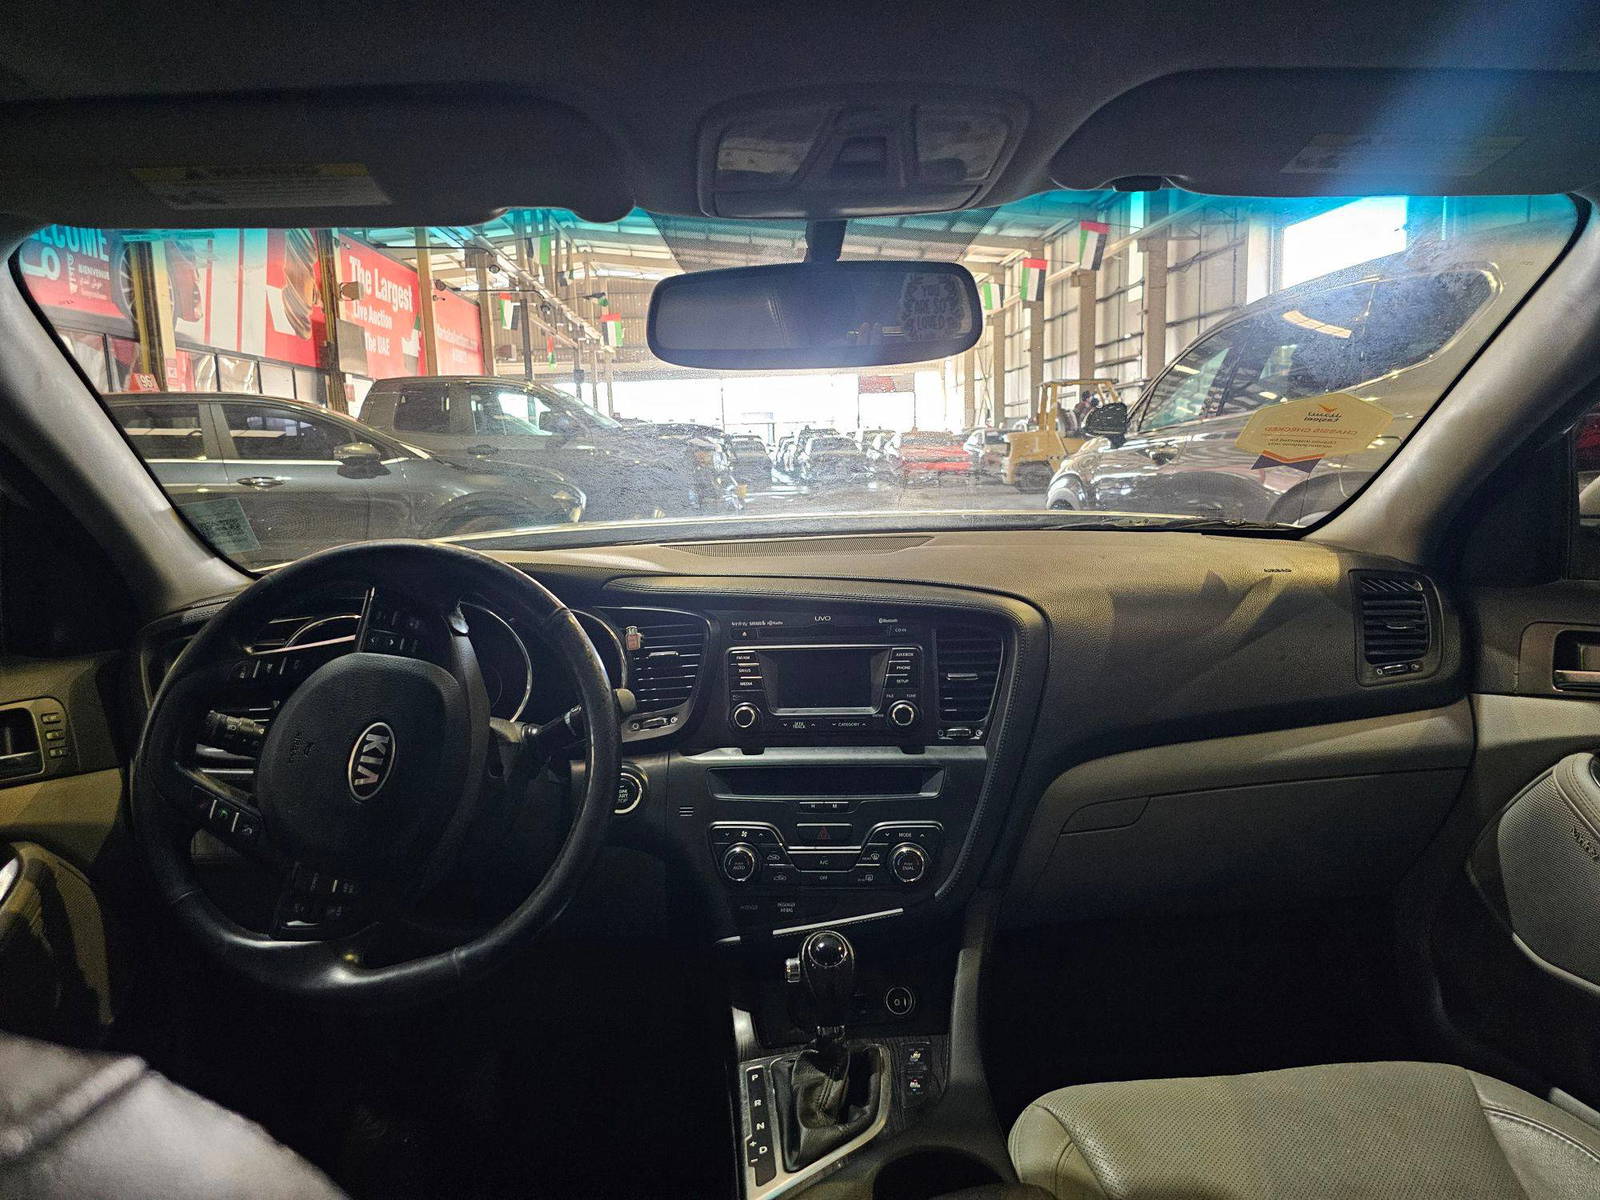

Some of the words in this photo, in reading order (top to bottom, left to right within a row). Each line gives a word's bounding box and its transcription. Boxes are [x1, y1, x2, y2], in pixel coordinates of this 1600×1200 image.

[349, 255, 372, 296] The
[374, 267, 414, 313] Largest
[367, 306, 393, 330] Auction
[354, 733, 390, 786] KIA
[754, 1099, 762, 1107] R
[756, 1122, 765, 1130] N
[759, 1145, 768, 1154] D
